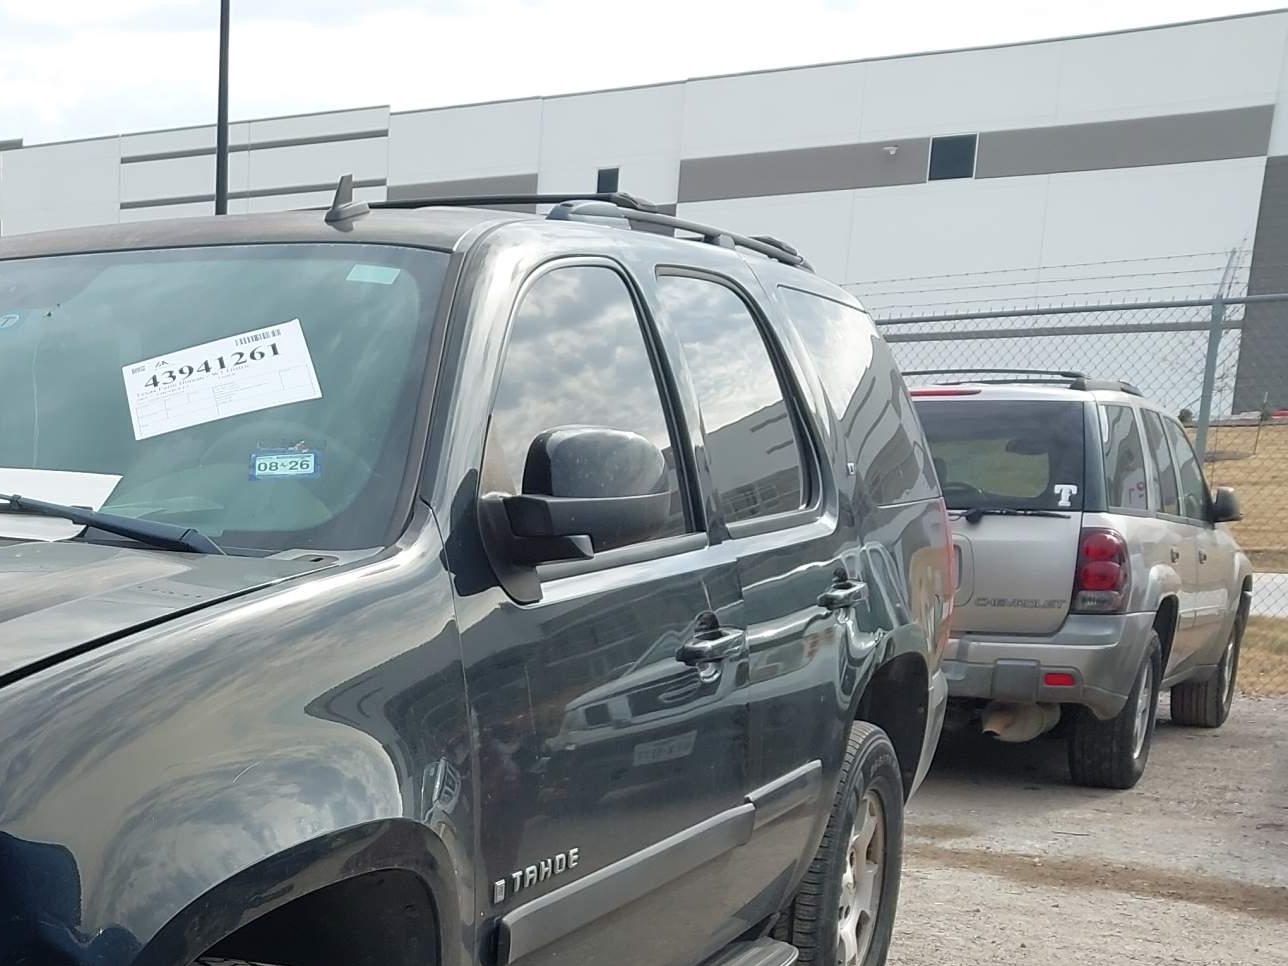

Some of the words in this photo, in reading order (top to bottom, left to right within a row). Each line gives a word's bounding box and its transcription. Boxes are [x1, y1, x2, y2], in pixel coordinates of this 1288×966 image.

[144, 342, 280, 388] 43941261
[1054, 484, 1078, 506] T
[512, 847, 579, 892] TAHOE
